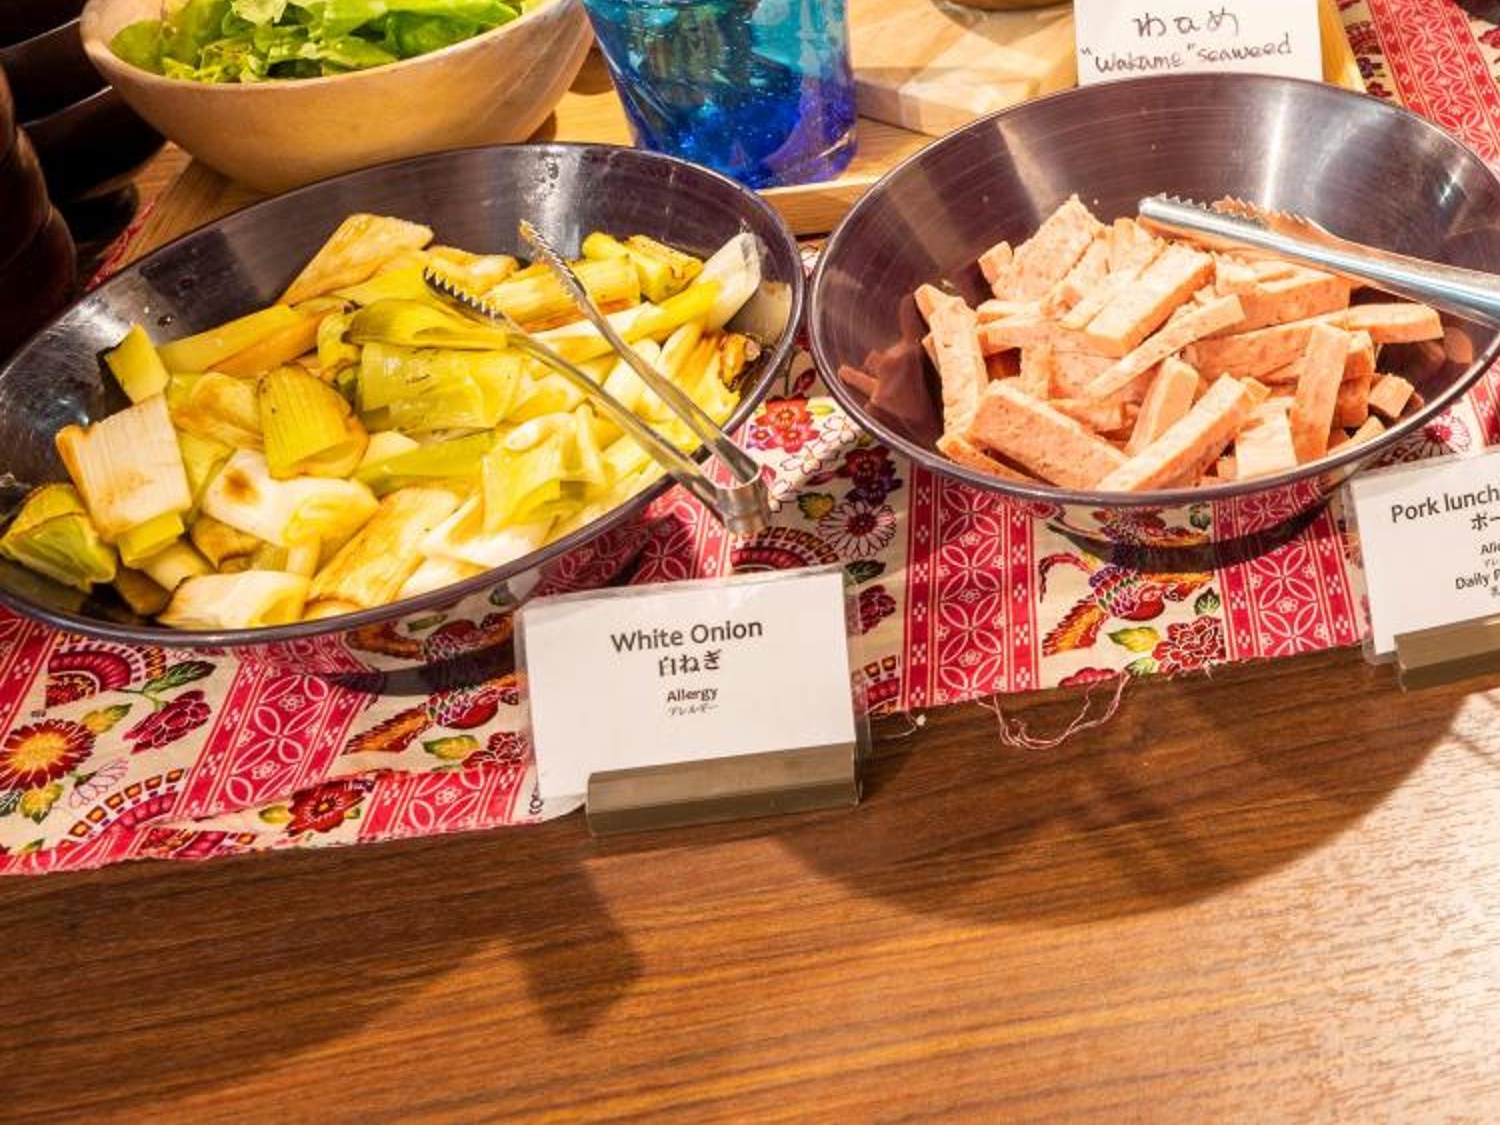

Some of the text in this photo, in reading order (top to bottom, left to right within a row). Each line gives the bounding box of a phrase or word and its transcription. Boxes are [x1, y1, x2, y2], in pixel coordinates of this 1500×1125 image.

[1391, 497, 1441, 523] Pork
[1455, 570, 1490, 591] Daily
[611, 620, 763, 653] White Onion
[659, 649, 722, 677] 白ねぎ
[666, 686, 718, 704] Allergy
